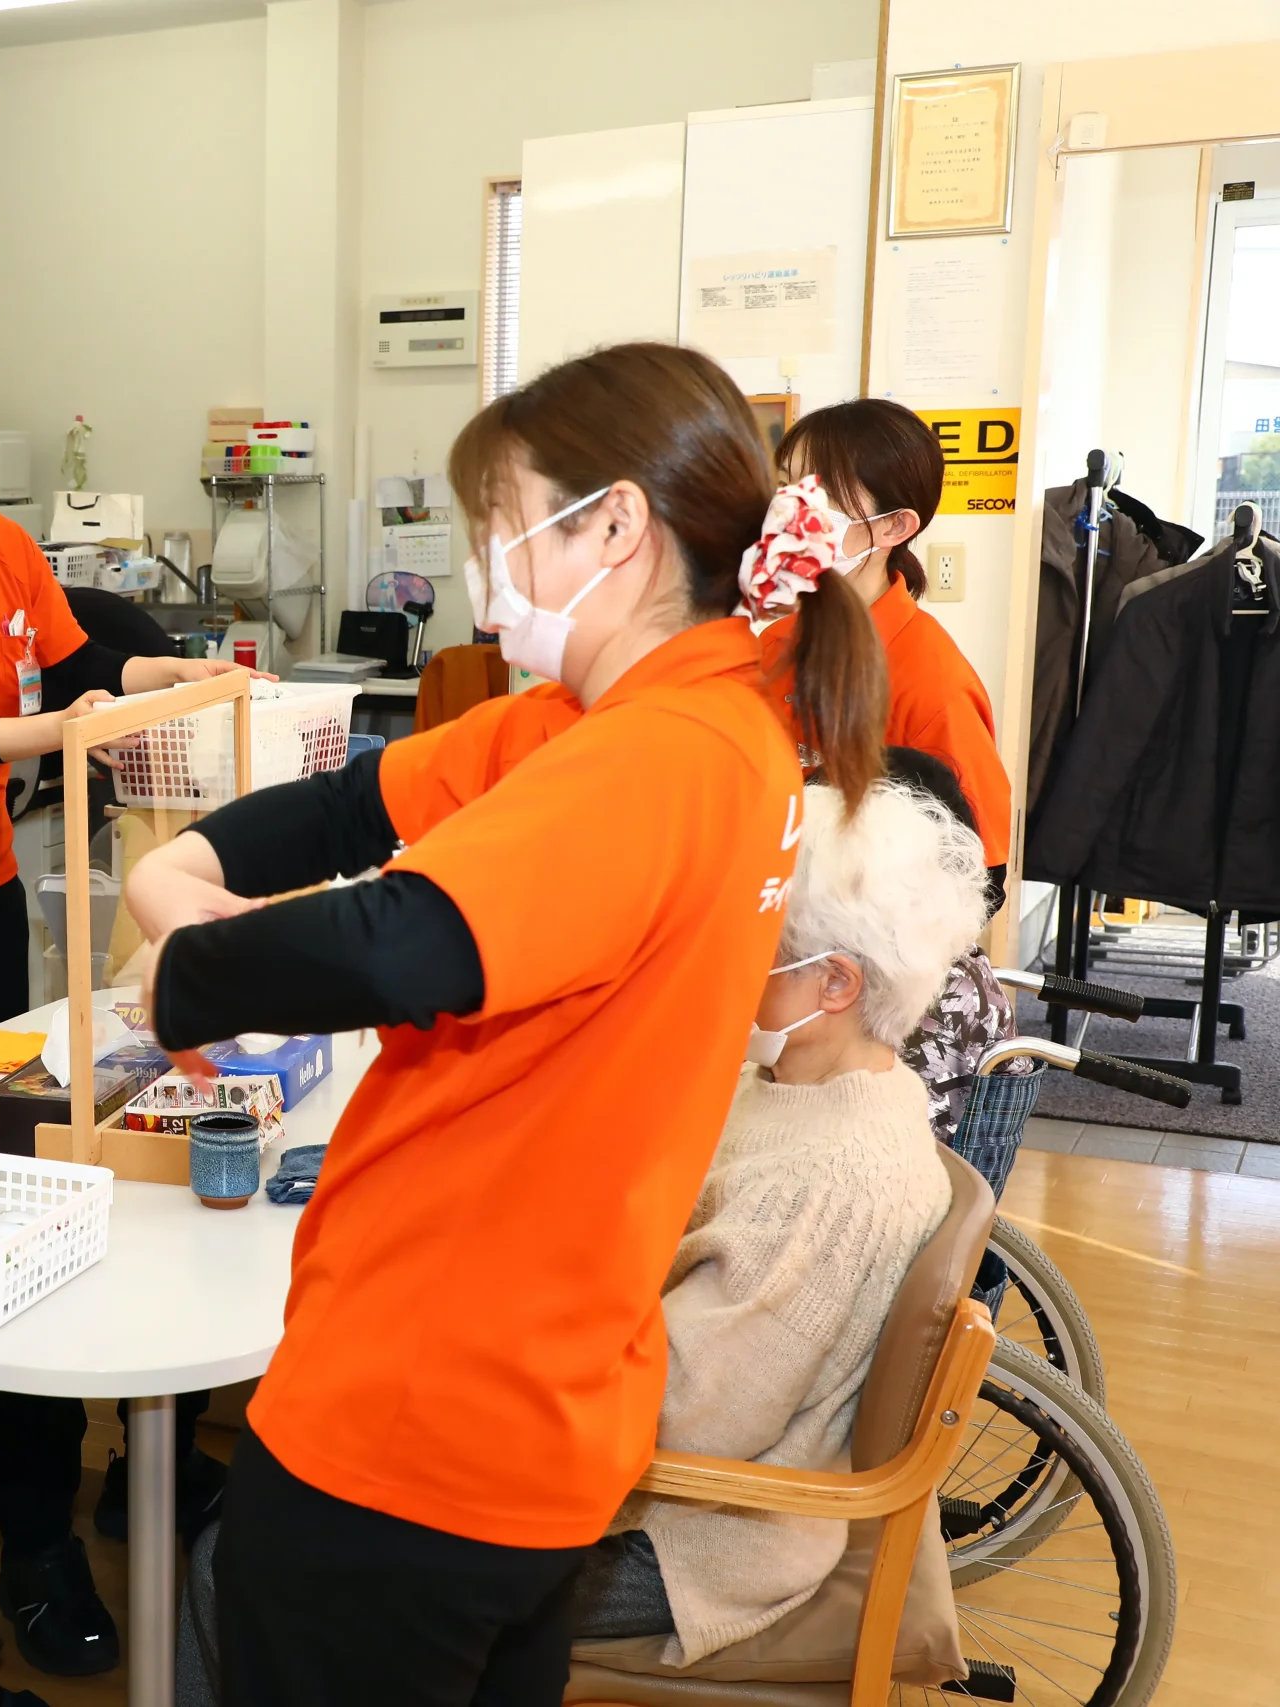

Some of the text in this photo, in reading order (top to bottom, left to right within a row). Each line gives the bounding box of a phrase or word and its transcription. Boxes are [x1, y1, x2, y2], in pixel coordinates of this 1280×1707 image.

[931, 420, 1015, 453] ED
[958, 469, 1013, 477] DEFIBRILLATOR
[299, 1061, 314, 1088] Hello
